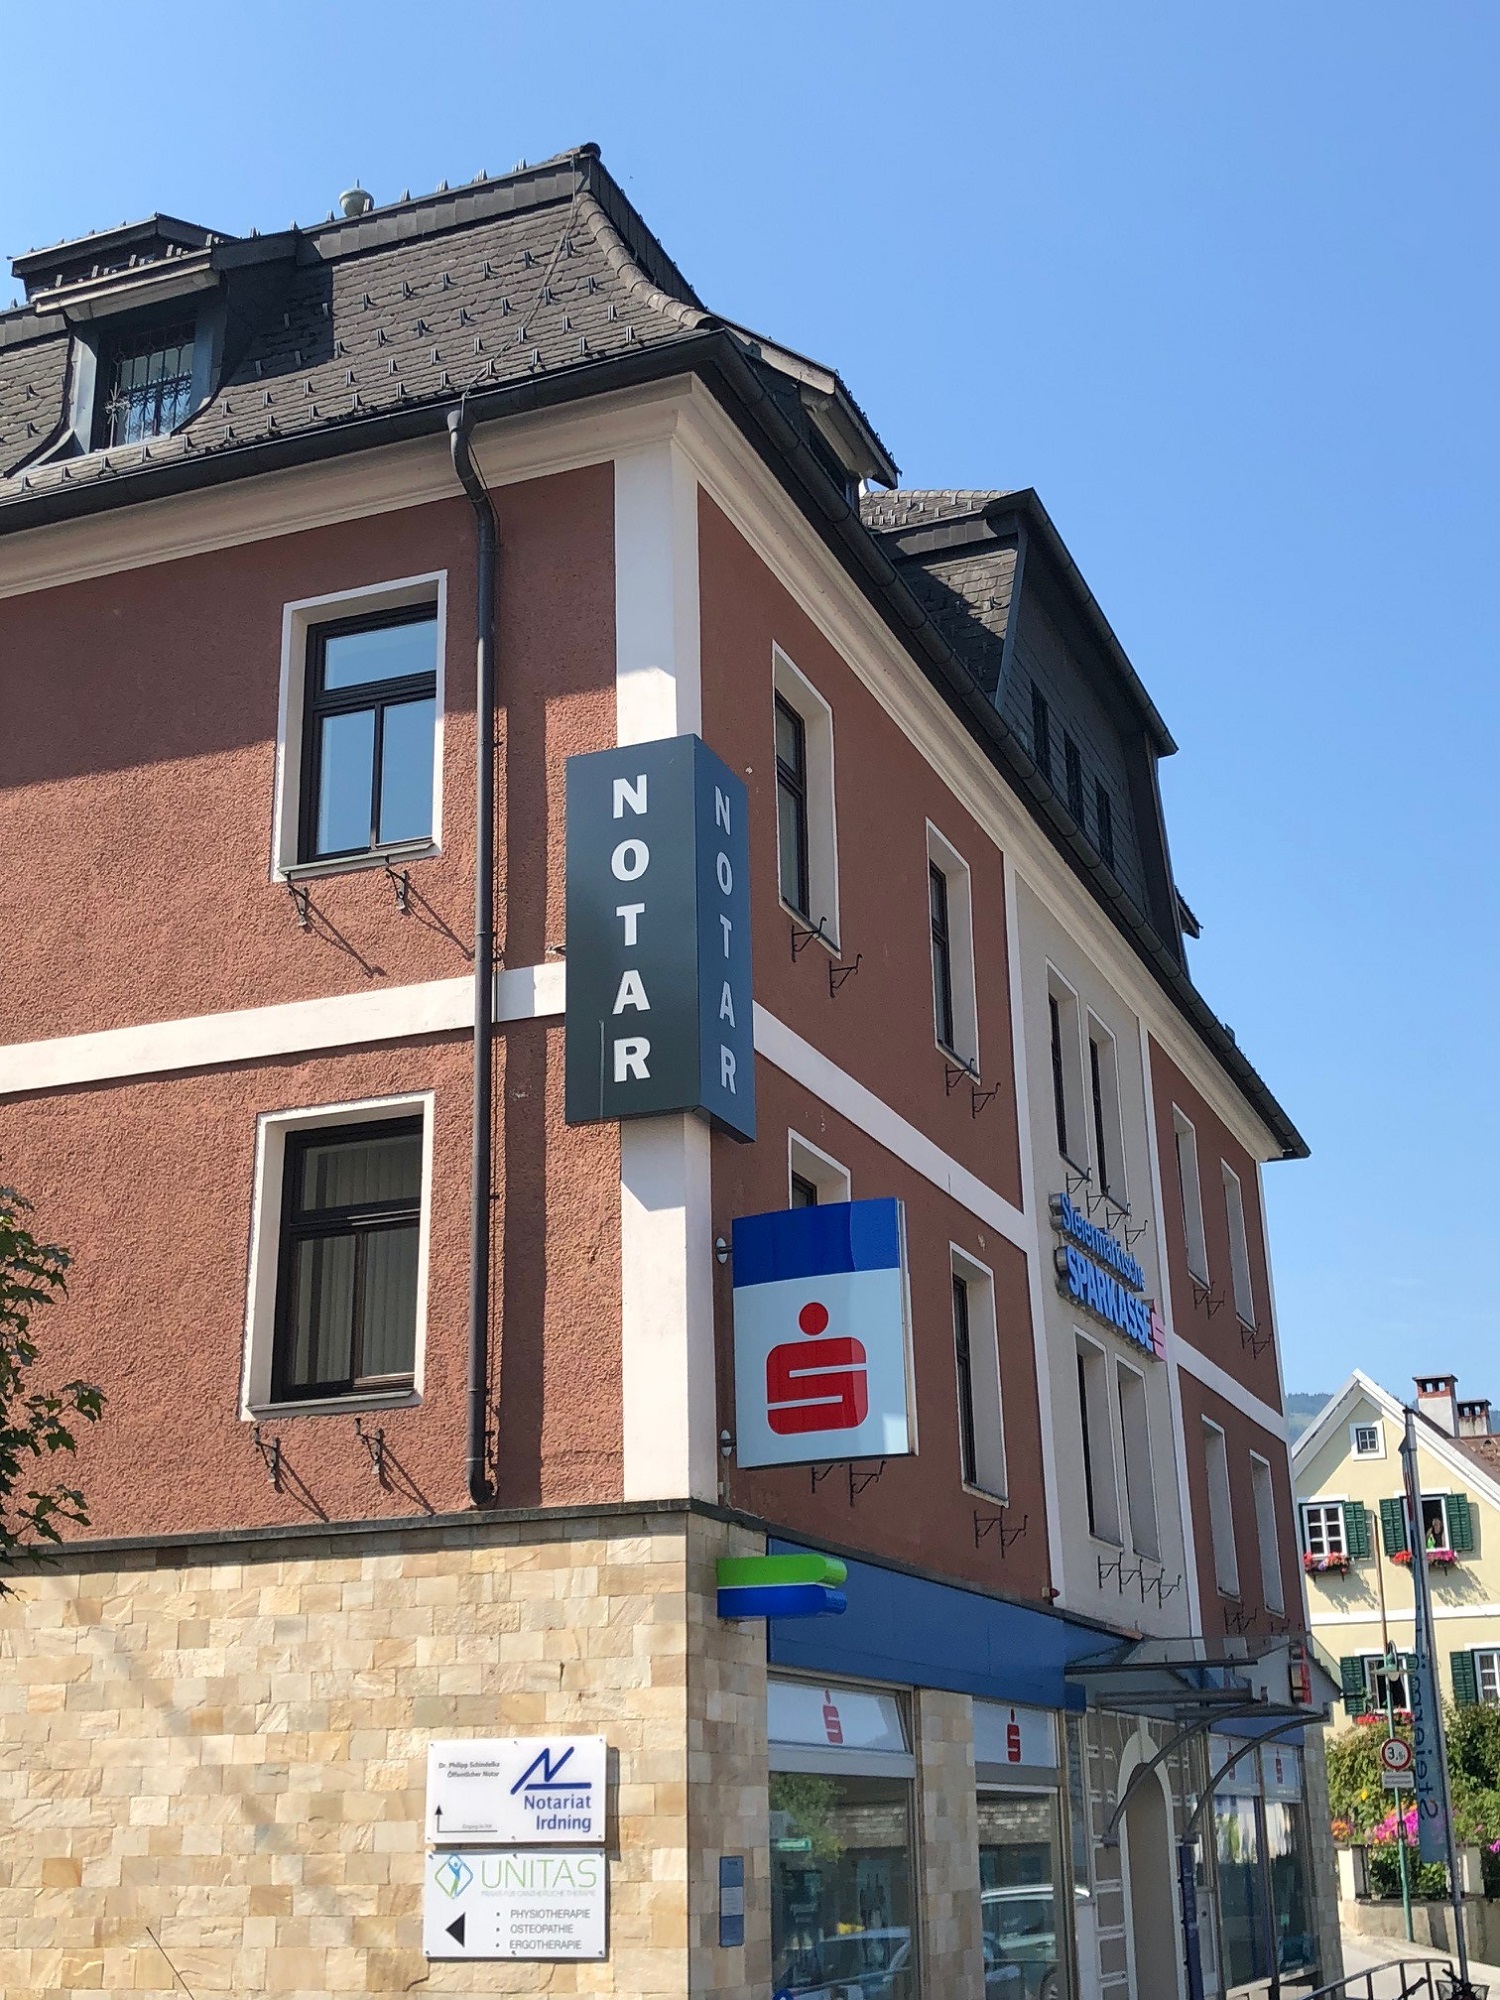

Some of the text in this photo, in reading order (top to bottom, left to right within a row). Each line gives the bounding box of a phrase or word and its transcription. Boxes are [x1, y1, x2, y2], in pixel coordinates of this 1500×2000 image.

[611, 774, 651, 1083] NOTAR
[714, 786, 737, 1096] NOTAR
[1066, 1246, 1154, 1353] SPARKASSE
[524, 1794, 593, 1810] Notariat
[536, 1814, 593, 1833] Irdning
[481, 1858, 597, 1889] UNITAS
[510, 1909, 591, 1919] PHYSIOTHERAPIE
[509, 1923, 574, 1934] OSTEOPATHIE
[509, 1939, 582, 1950] ERGOTHERAPIE
